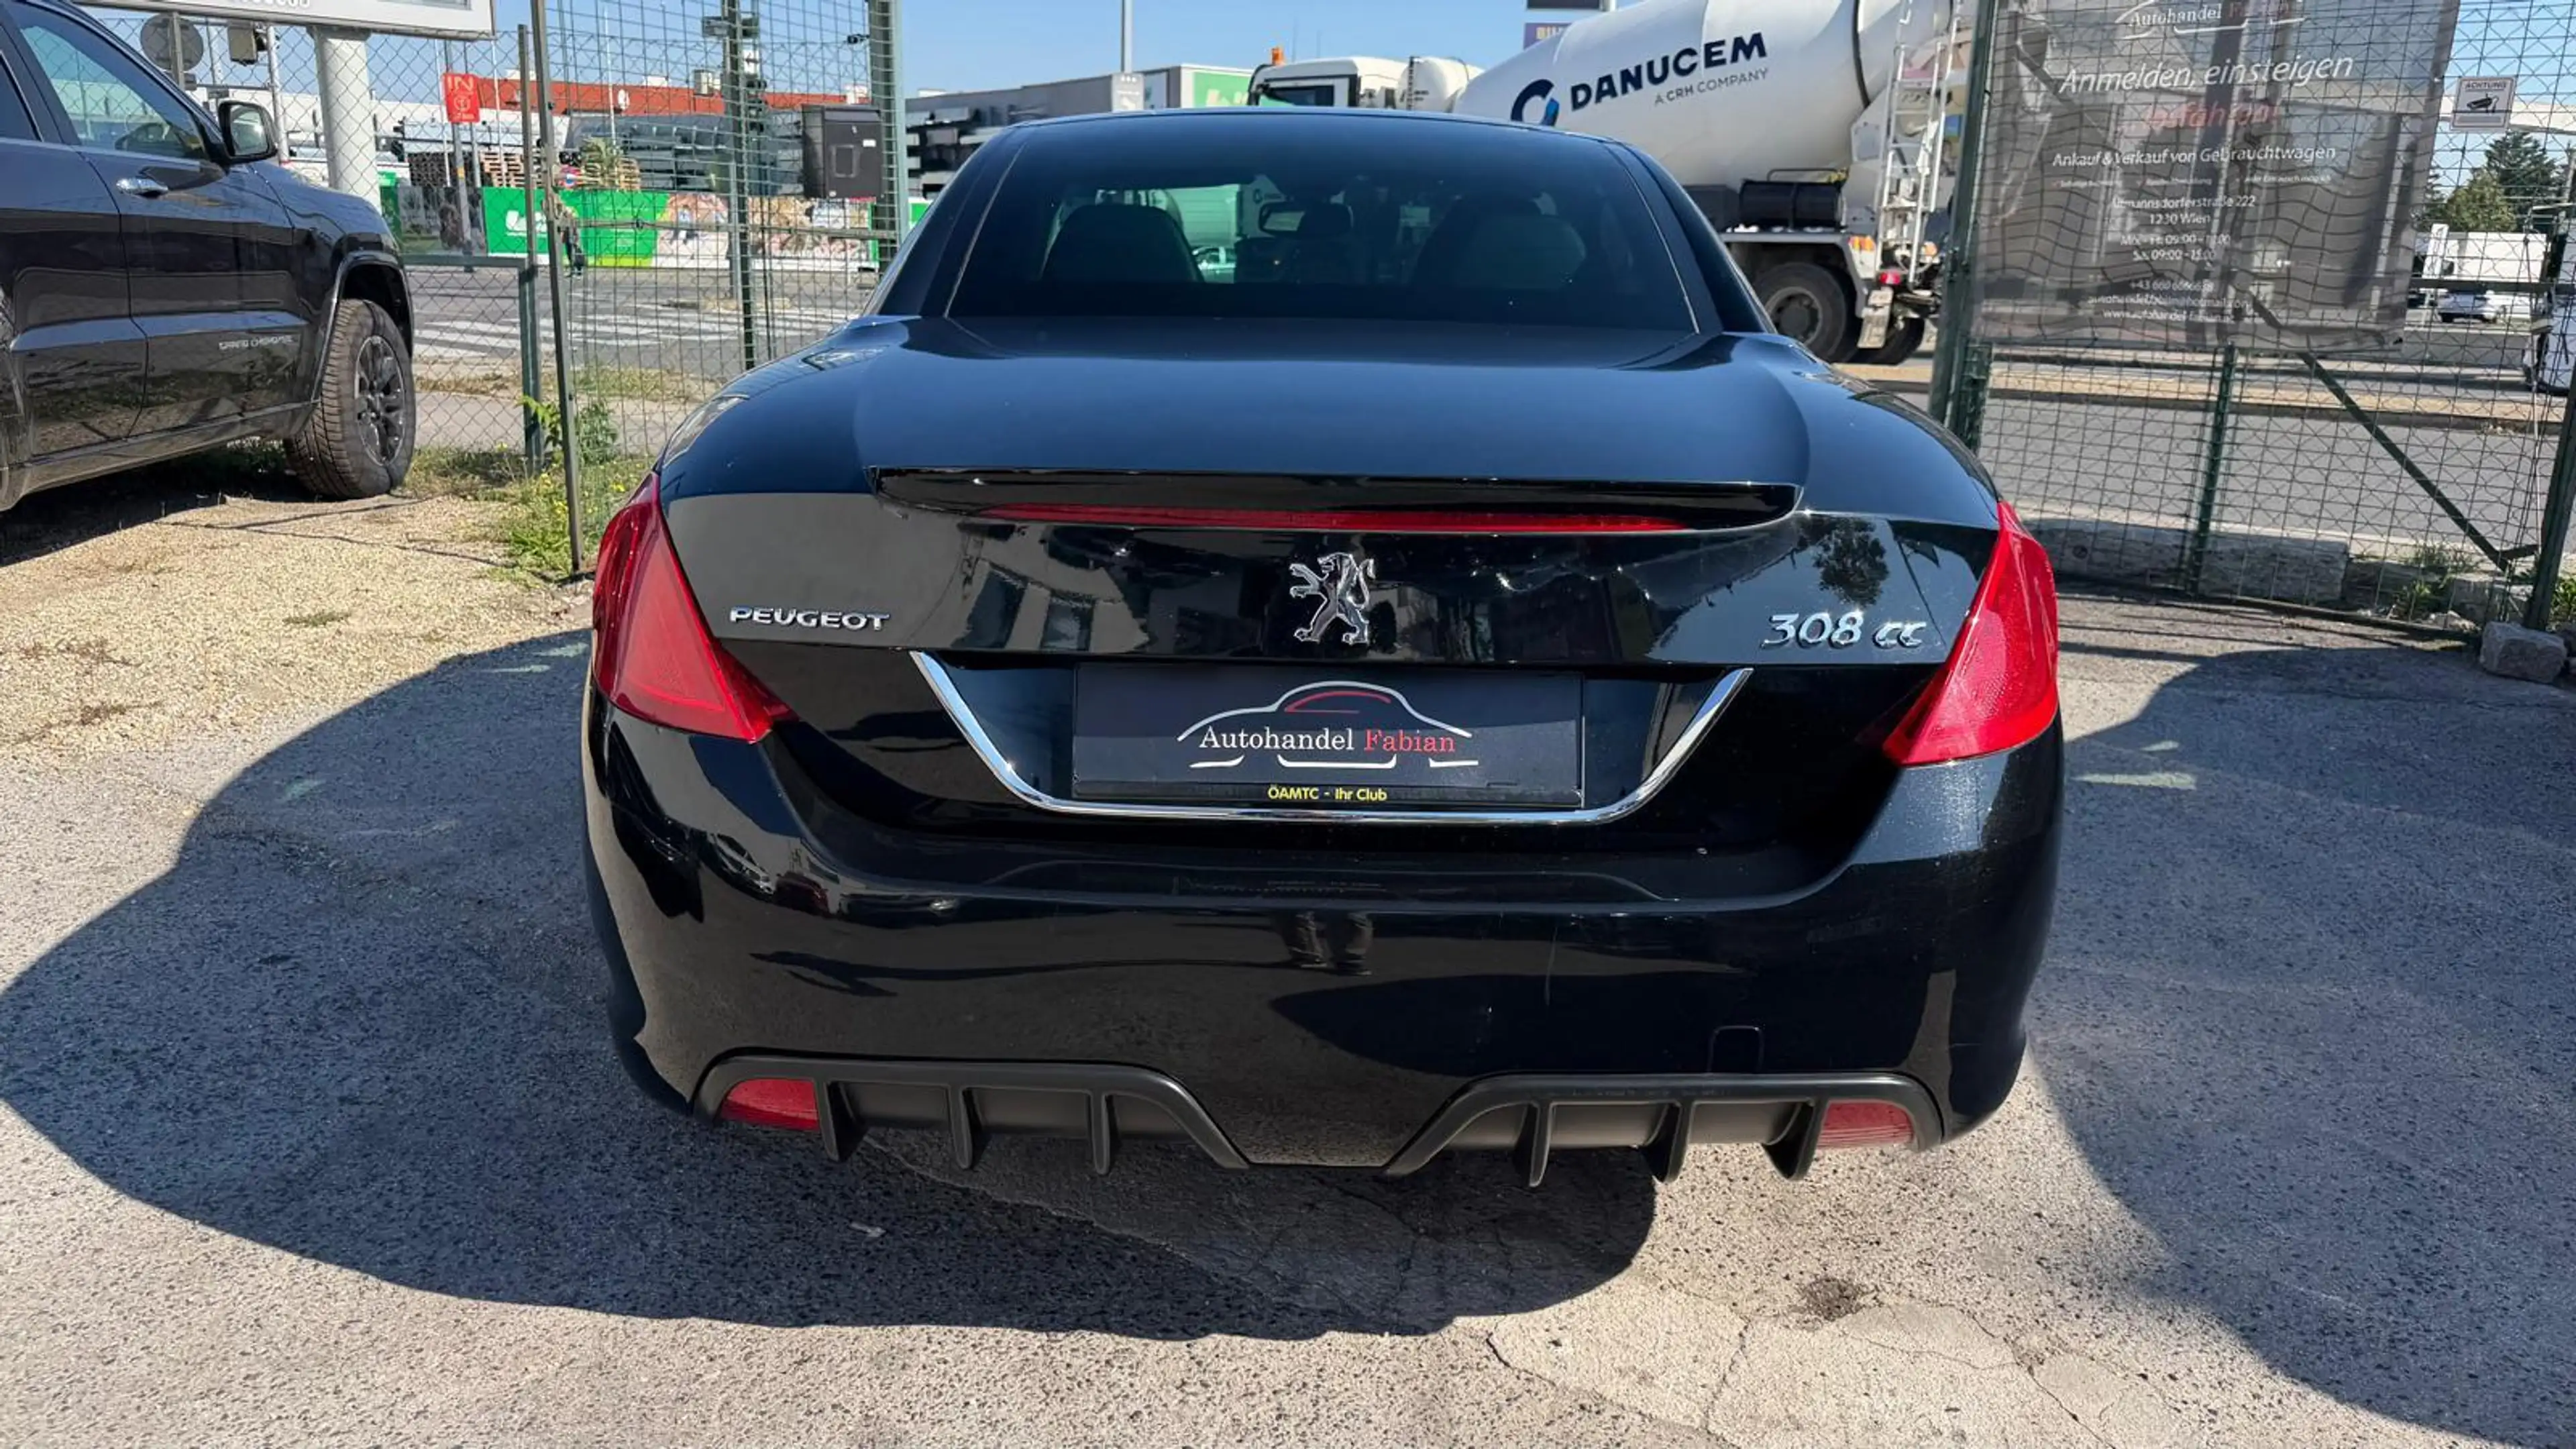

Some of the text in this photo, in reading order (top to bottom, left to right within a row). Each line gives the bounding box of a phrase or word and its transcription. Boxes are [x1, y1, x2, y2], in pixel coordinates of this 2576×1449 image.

[2130, 3, 2222, 26] Autohandel
[1570, 32, 1768, 111] DANUCEM
[2058, 55, 2353, 93] Anmelden, einsteigen
[1654, 68, 1769, 106] A CRH COMPANY
[2053, 151, 2100, 166] Ankauf
[2170, 152, 2196, 163] von
[2200, 145, 2337, 162] Gebrauchtwagen
[729, 606, 891, 631] PEUGEOT
[1762, 609, 1864, 647] 308
[1199, 724, 1456, 753] Autohandel Fabian
[1267, 784, 1319, 800] ÖAMTC
[1334, 788, 1354, 801] Ihr
[1356, 788, 1388, 802] Club
